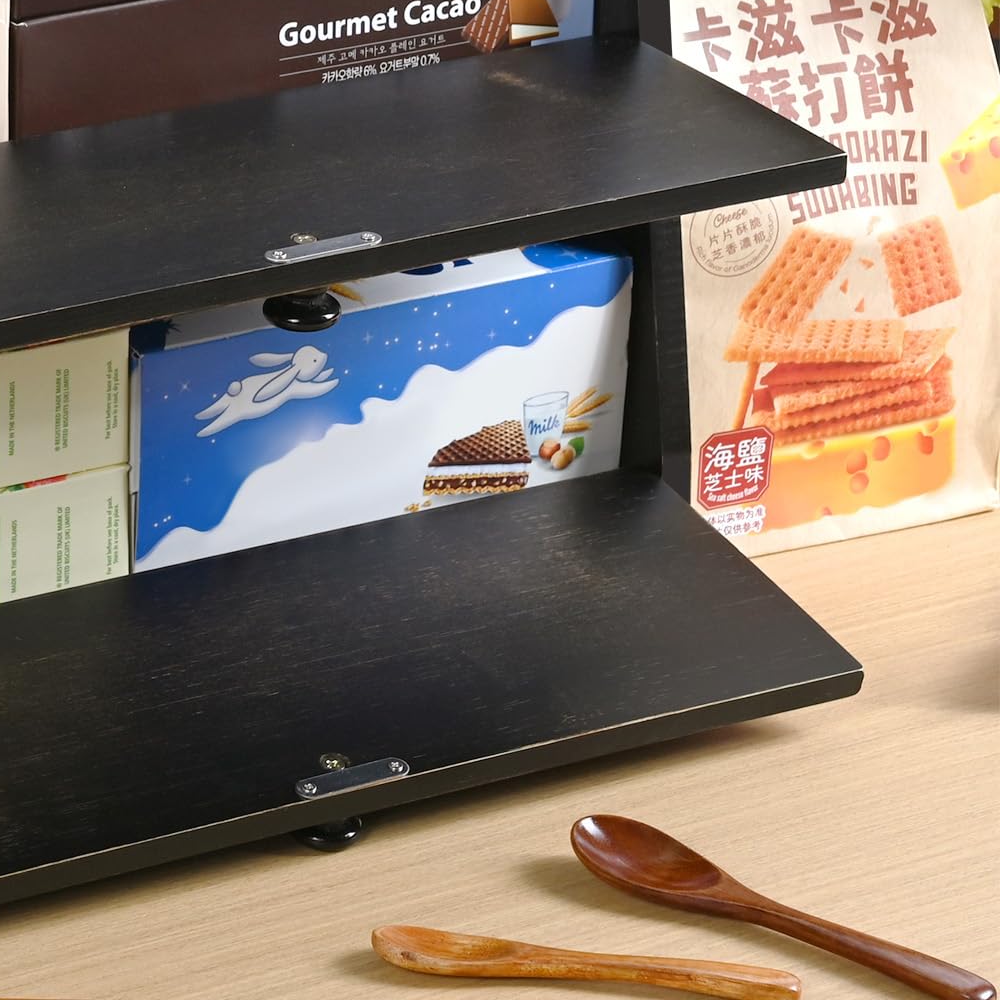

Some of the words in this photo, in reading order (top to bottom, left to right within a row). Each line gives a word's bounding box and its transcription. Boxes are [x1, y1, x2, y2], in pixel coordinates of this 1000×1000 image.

[279, 6, 398, 47] Gourmet
[713, 208, 748, 228] Cheese
[8, 381, 16, 421] NETHERLANDS
[8, 439, 16, 456] MADE
[703, 436, 768, 473] 海鹽
[703, 464, 764, 494] 芝士味
